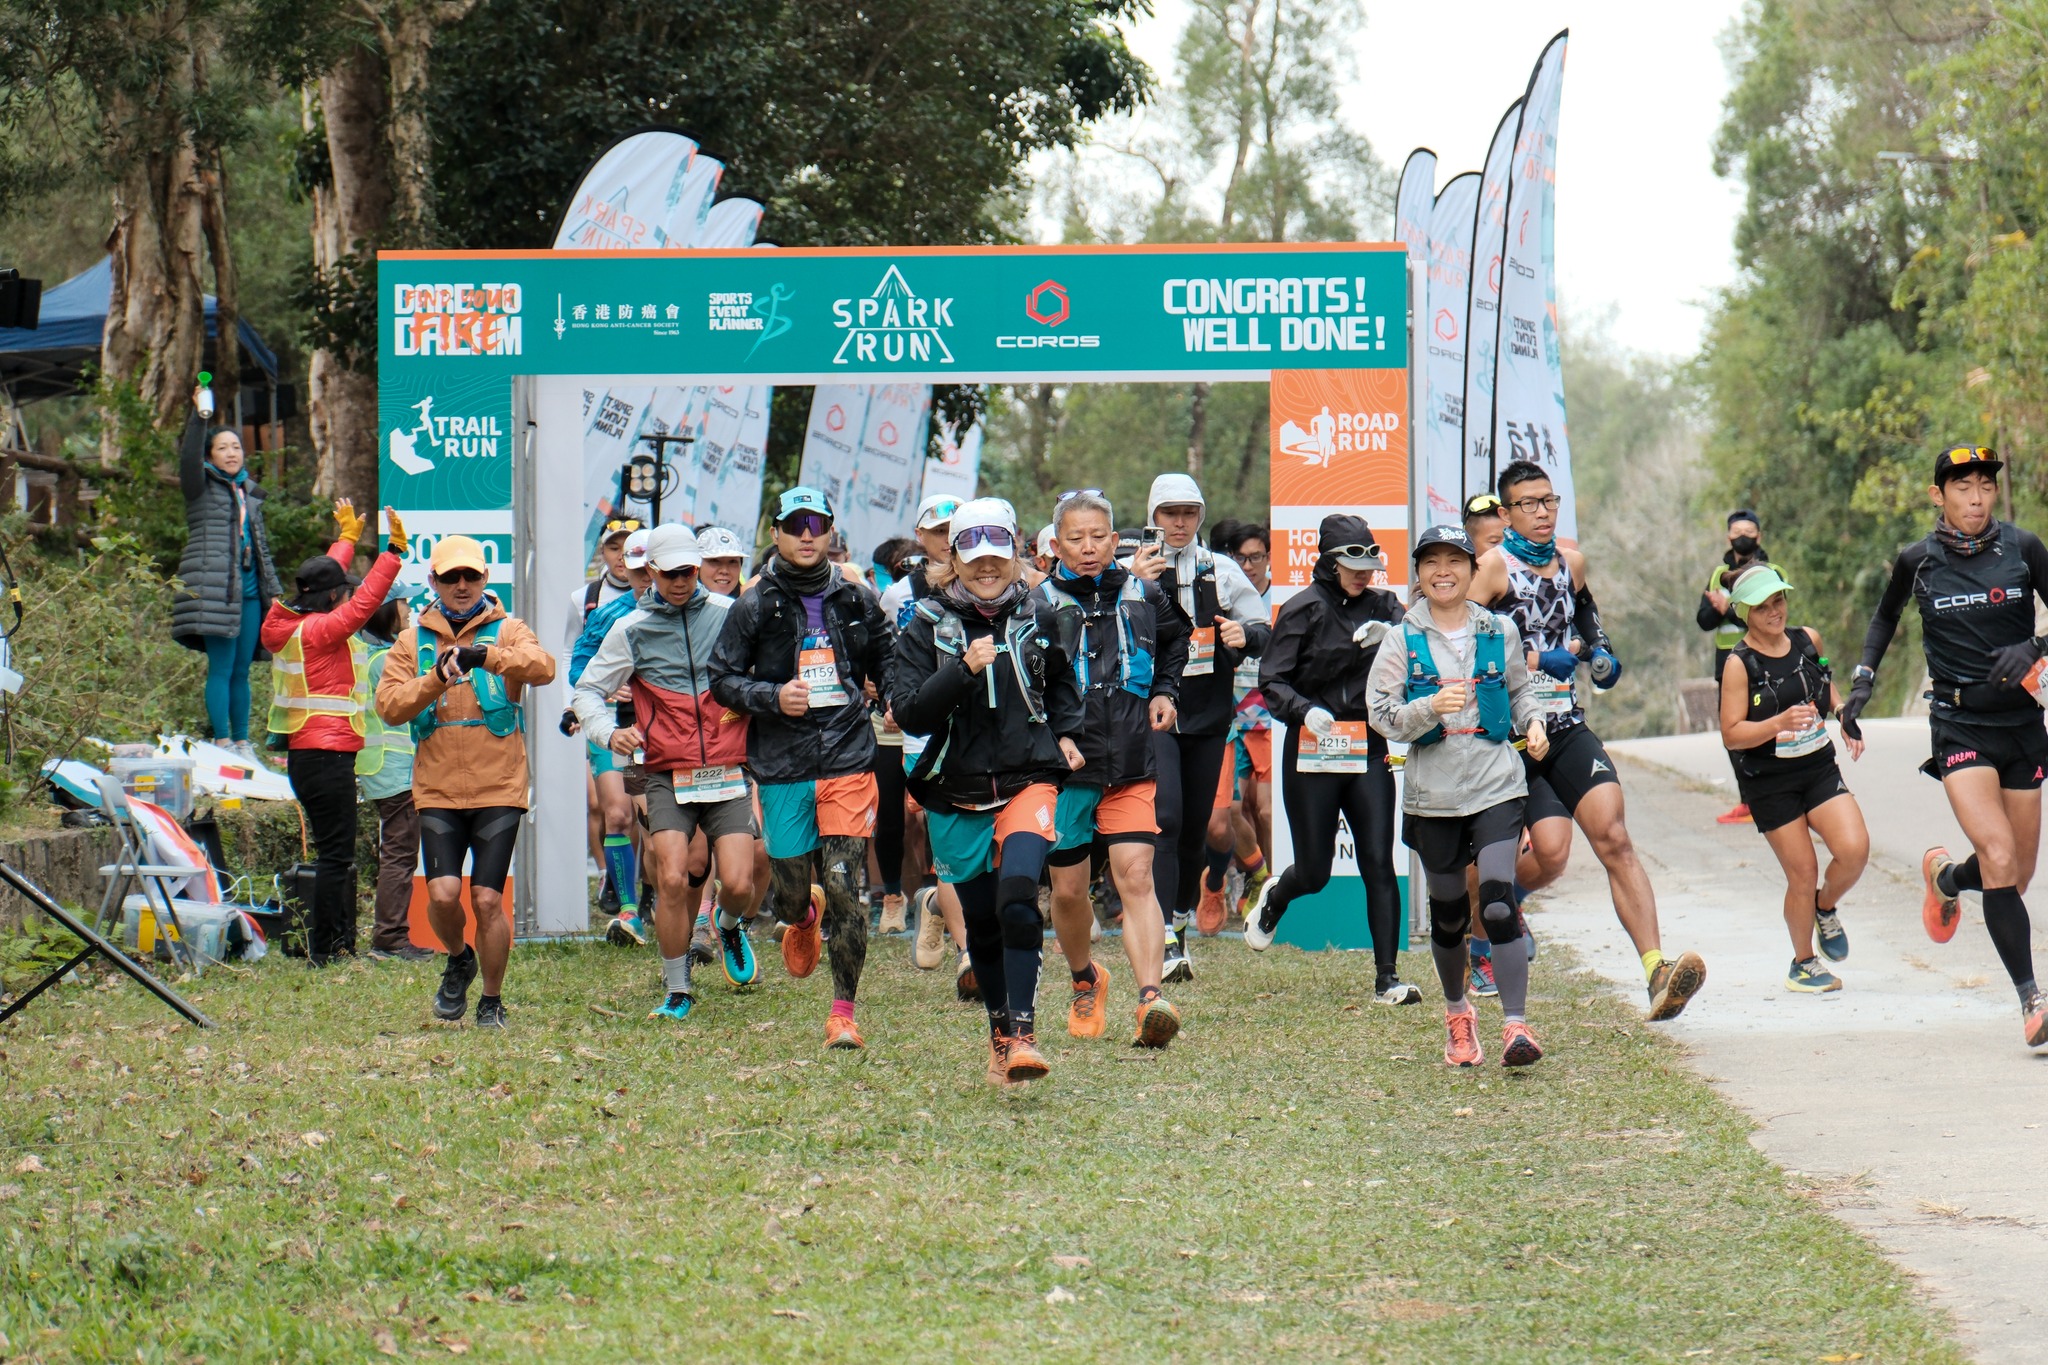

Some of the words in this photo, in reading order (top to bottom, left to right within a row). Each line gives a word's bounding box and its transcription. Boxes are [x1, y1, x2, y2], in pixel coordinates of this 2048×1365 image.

[709, 292, 753, 305] SPORTS
[1163, 276, 1367, 316] CONGRATS!
[572, 303, 680, 320] 香港防癌會
[709, 305, 749, 318] EVENT
[832, 297, 954, 330] SPARK
[709, 317, 764, 331] PLANNER
[996, 334, 1100, 349] COROS
[1182, 316, 1271, 352] WELL
[1280, 315, 1386, 351] DONE!
[857, 329, 933, 364] RUN
[433, 416, 502, 437] TRAIL
[1338, 412, 1399, 432] ROAD
[444, 437, 498, 458] RUN
[1338, 432, 1388, 452] RUN
[1934, 588, 2023, 610] COROS
[803, 666, 835, 679] 4159
[1530, 673, 1554, 685] 094
[1319, 737, 1348, 748] 4215
[1946, 750, 1977, 768] JEREMY
[694, 768, 723, 779] 4222
